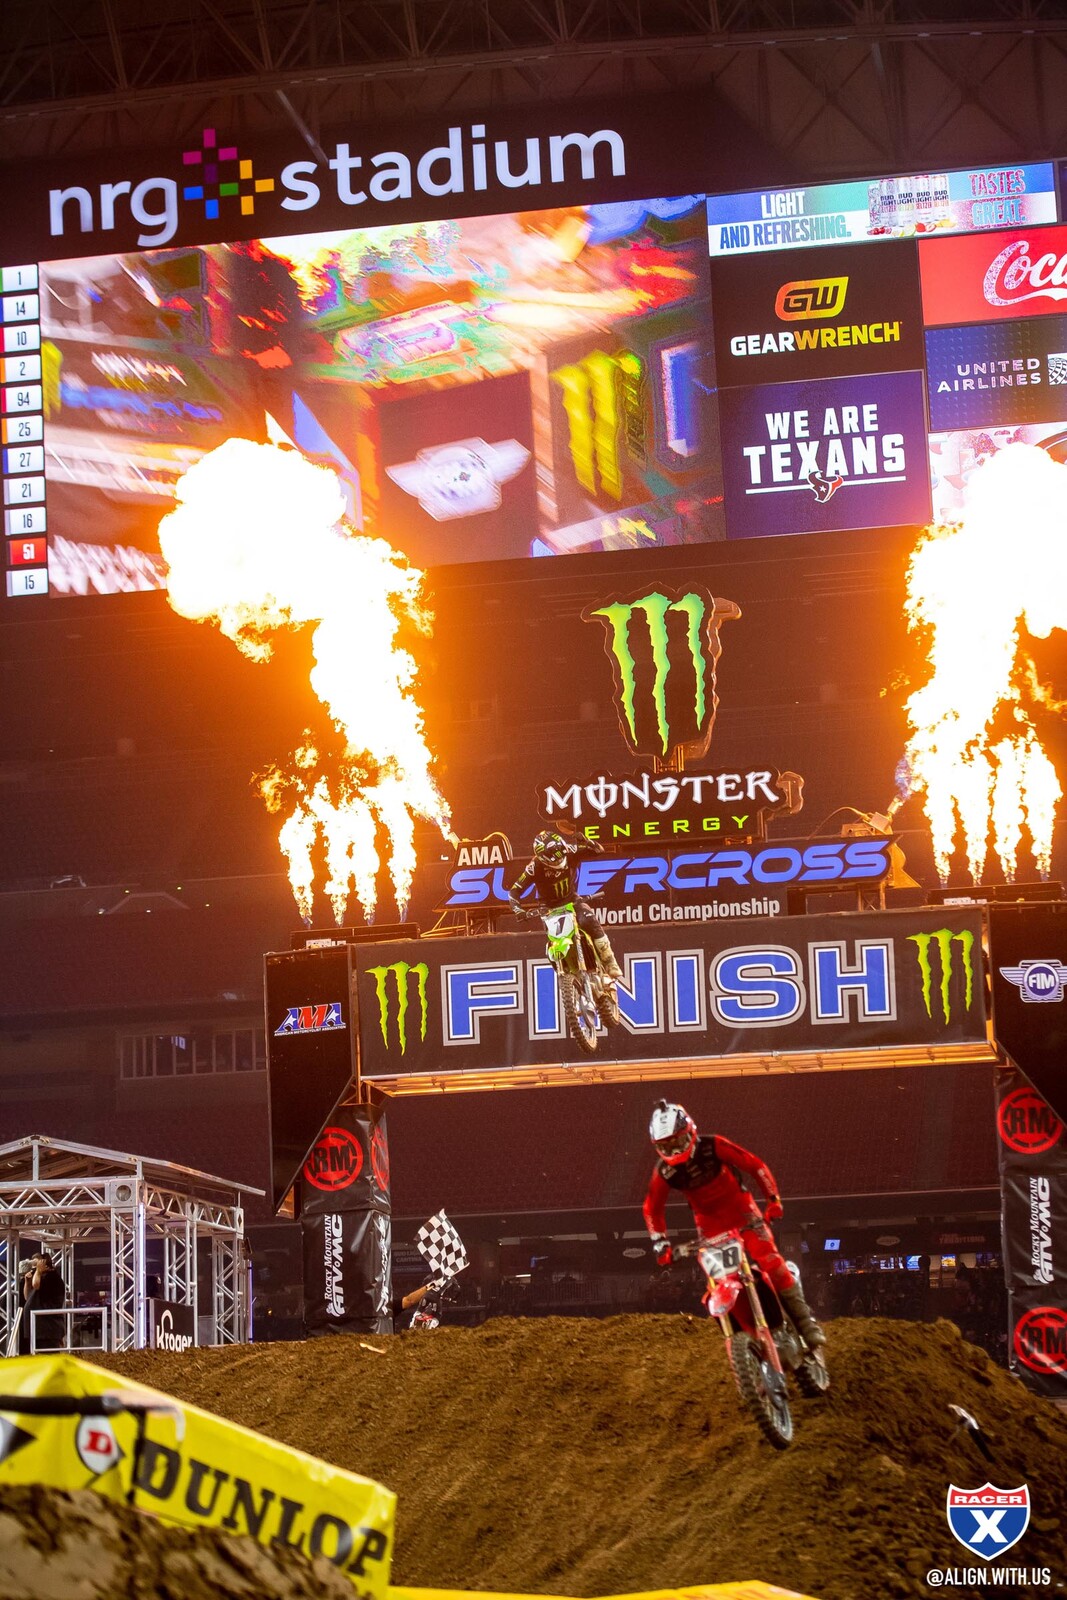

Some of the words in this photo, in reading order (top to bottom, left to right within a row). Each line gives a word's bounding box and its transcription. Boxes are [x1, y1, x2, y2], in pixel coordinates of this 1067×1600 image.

[48, 177, 178, 247] nrg
[280, 124, 626, 212] stadium
[898, 192, 913, 200] BUD
[968, 168, 1026, 197] TASTES
[760, 191, 805, 219] LIGHT
[972, 198, 1027, 226] GREAT.
[720, 222, 750, 249] AND
[753, 214, 852, 247] REFRESHING.
[18, 271, 22, 286] 1
[16, 301, 26, 316] 14
[16, 331, 27, 346] 10
[730, 321, 901, 356] GEARWRENCH
[20, 361, 26, 376] 2
[957, 358, 1040, 377] UNITED
[937, 371, 1042, 393] AIRLINES
[17, 391, 30, 407] 94
[18, 421, 31, 437] 25
[765, 410, 809, 440] WE
[823, 403, 879, 435] ARE
[20, 452, 31, 468] 27
[743, 433, 907, 485] TEXANS
[21, 483, 32, 498] 21
[22, 513, 33, 529] 16
[22, 543, 35, 560] 51
[24, 574, 35, 590] 15
[544, 771, 779, 819] MONSTER
[584, 815, 749, 840] ENERGY
[457, 844, 503, 867] AMA
[447, 841, 890, 905] SUERCROSS
[648, 896, 780, 924] Championship
[553, 916, 566, 936] 1
[1028, 973, 1055, 990] FIM
[274, 1002, 347, 1033] AMA
[1010, 1107, 1055, 1135] RM
[312, 1145, 351, 1172] RM
[1030, 1177, 1040, 1233] MOUNTAIN
[324, 1214, 332, 1268] MOUNTAIN
[1031, 1233, 1040, 1267] ROCKY
[324, 1269, 332, 1301] ROCKY
[156, 1310, 193, 1353] Kroger
[84, 1430, 113, 1456] D
[137, 1438, 389, 1577] DUNLOP
